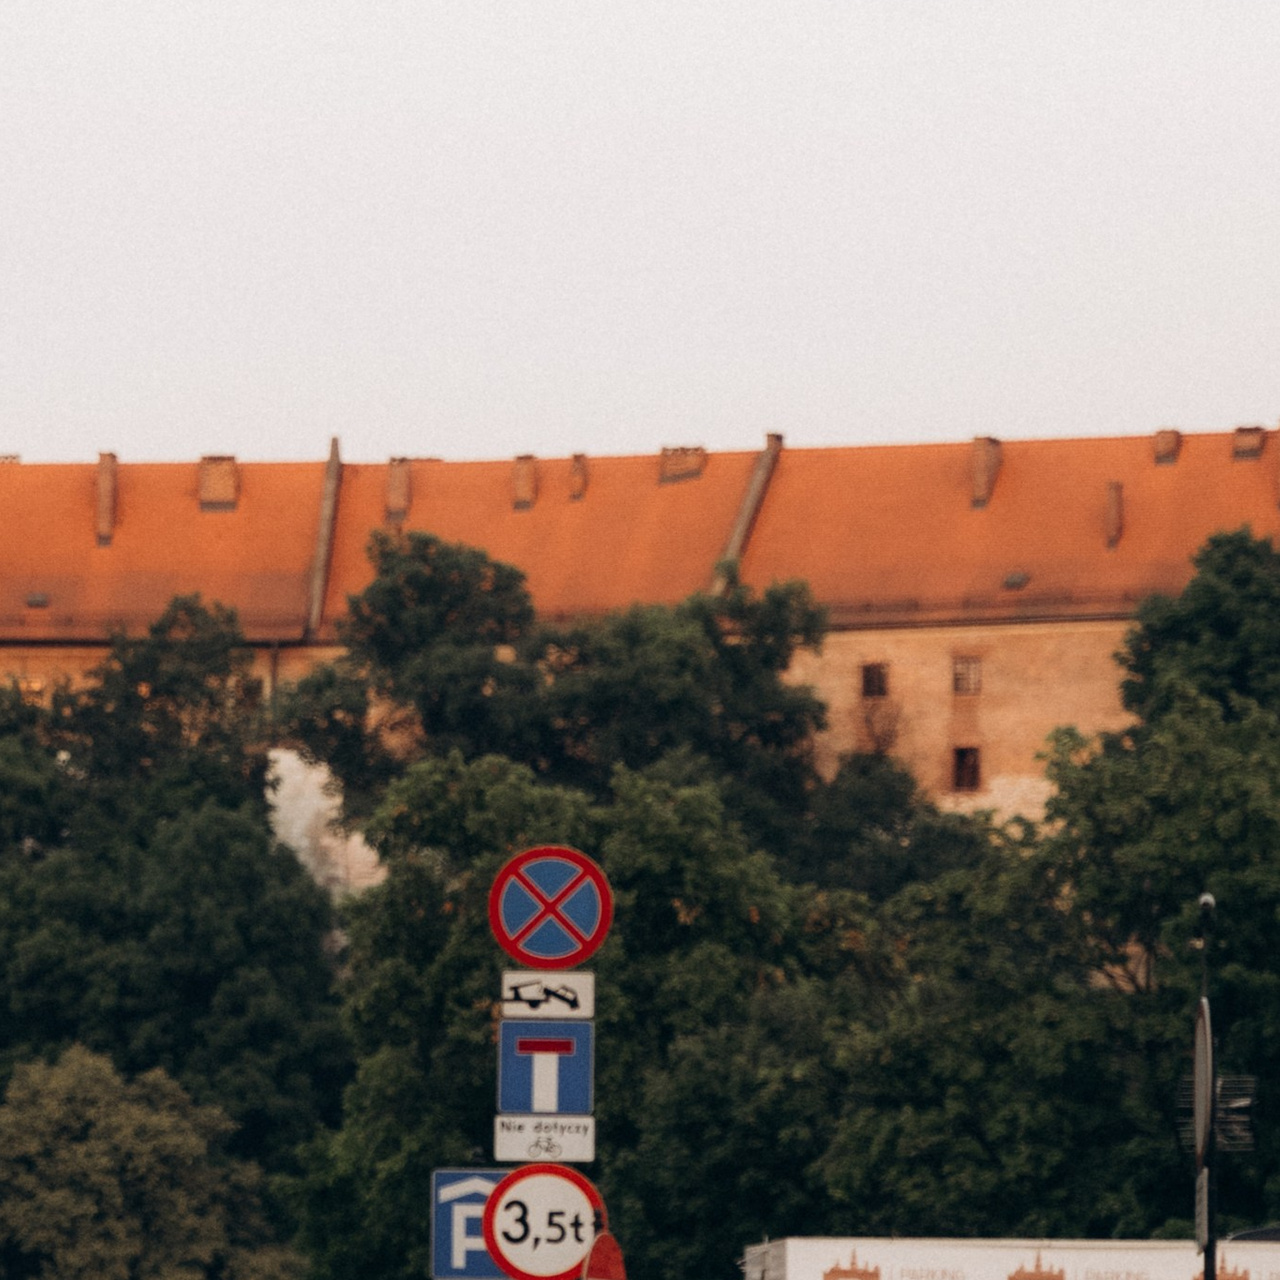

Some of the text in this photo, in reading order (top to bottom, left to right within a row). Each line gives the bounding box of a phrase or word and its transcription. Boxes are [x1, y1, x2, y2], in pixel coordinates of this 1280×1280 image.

[500, 1120, 590, 1136] Nie dotyczy
[502, 1200, 584, 1251] 3,5t
